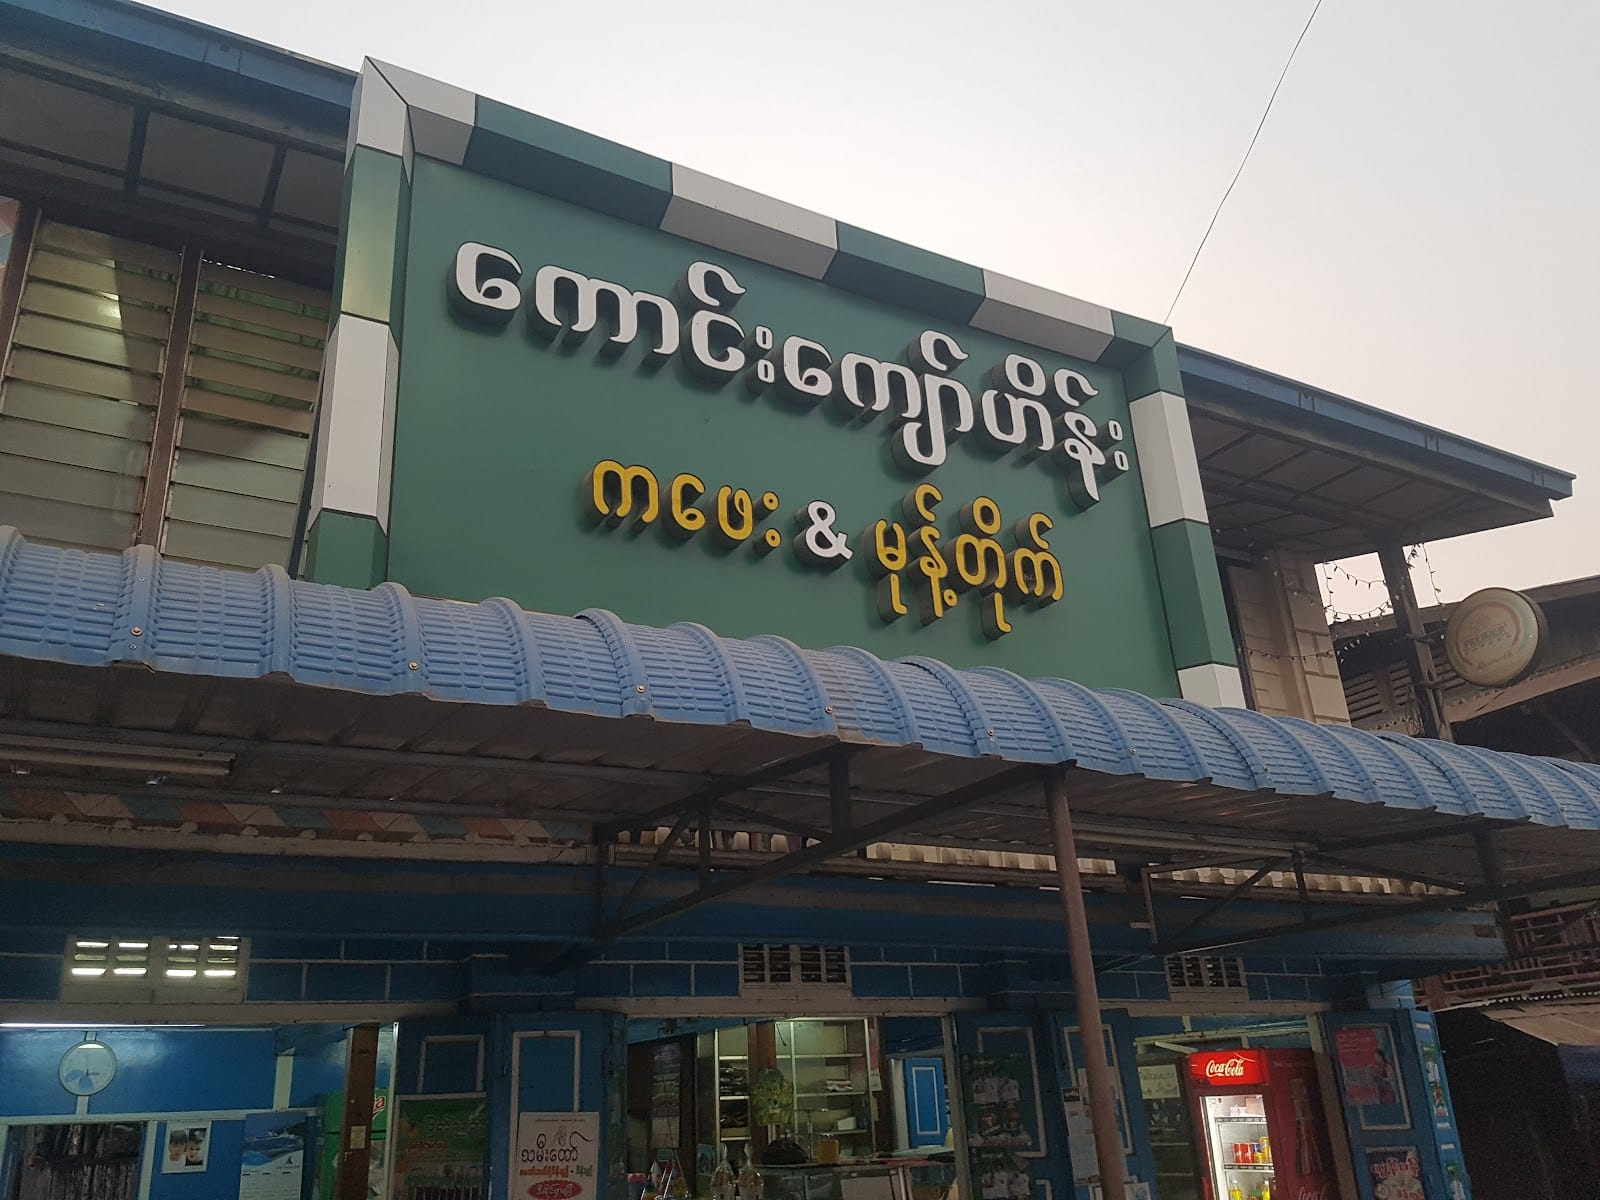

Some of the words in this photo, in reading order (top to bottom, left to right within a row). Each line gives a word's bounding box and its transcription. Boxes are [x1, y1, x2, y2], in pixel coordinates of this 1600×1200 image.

[454, 240, 1129, 502] ကောင်းကျော်ဟိန်း
[592, 458, 782, 548] ကဖေး
[805, 499, 854, 560] &
[1205, 1058, 1245, 1078] Coca-Cola
